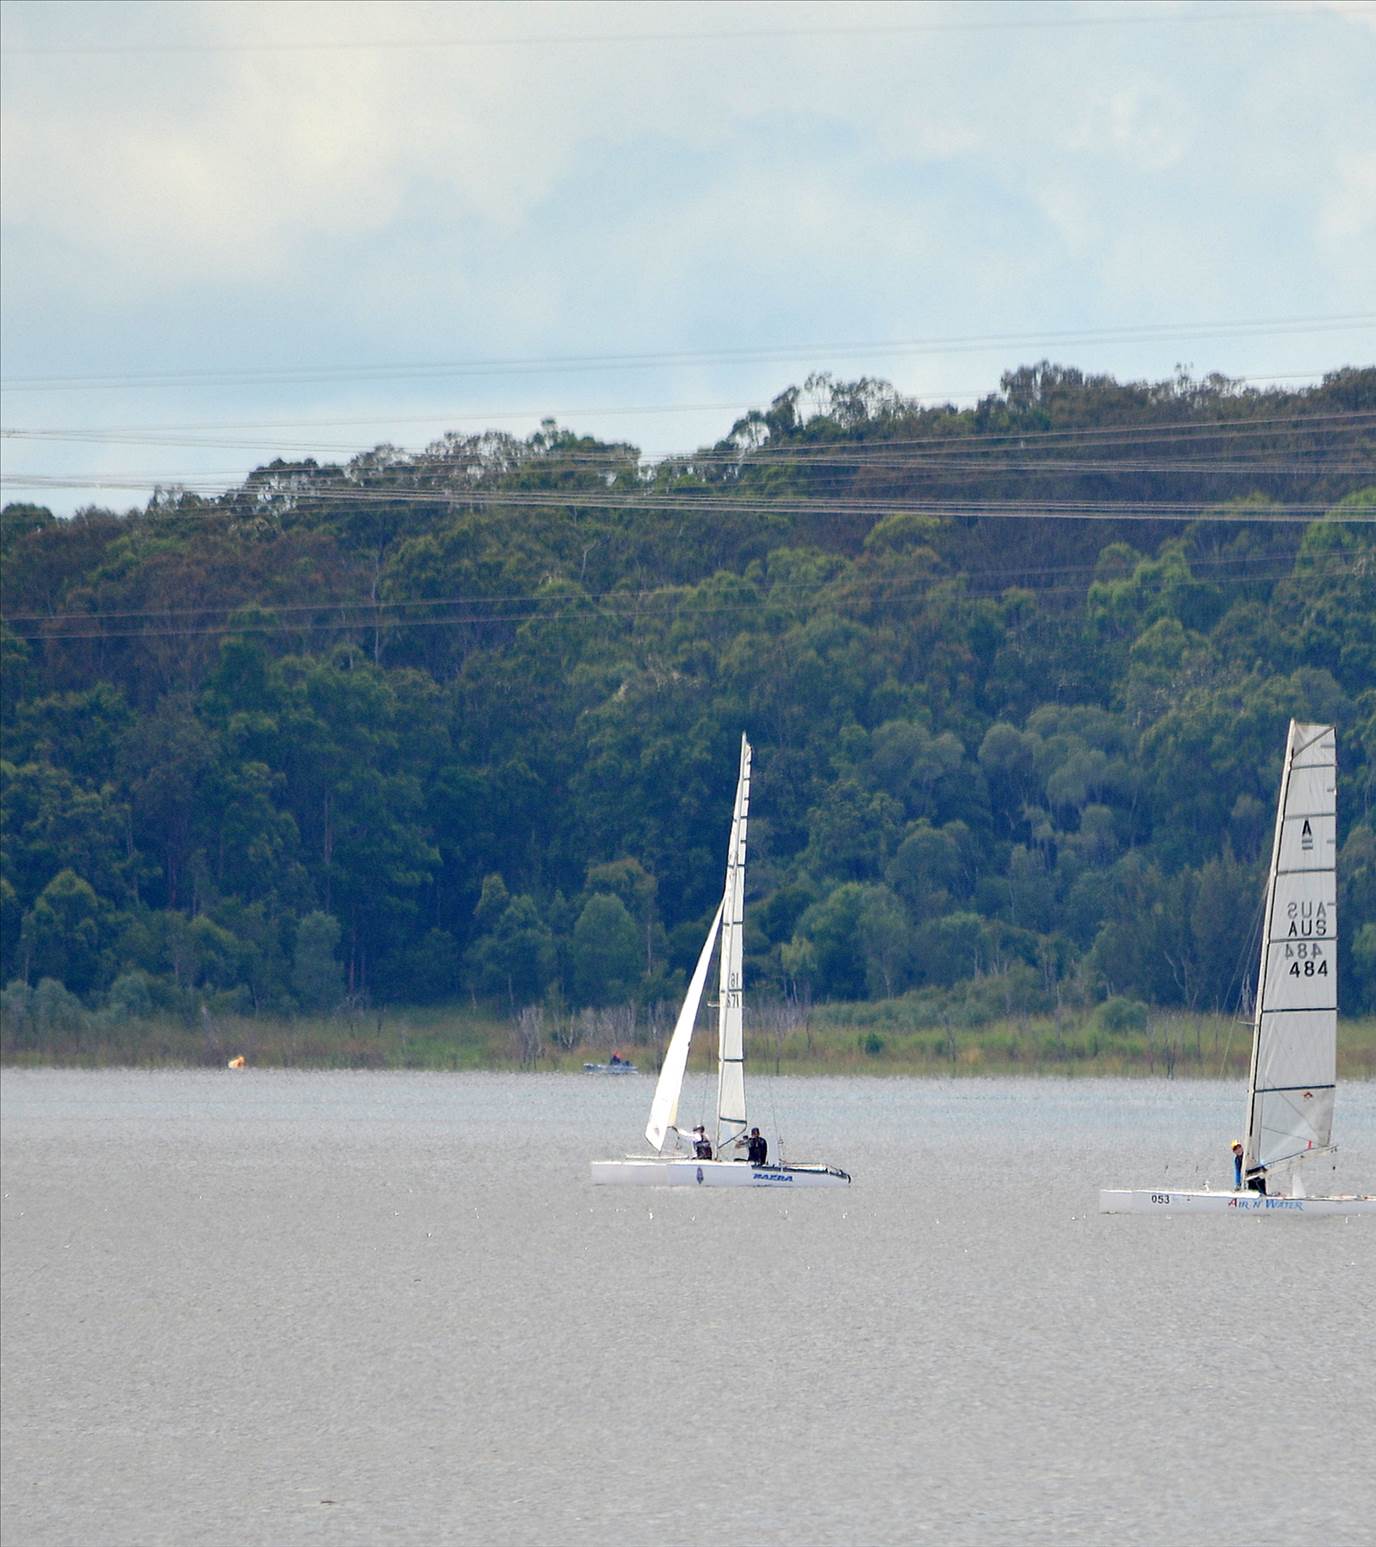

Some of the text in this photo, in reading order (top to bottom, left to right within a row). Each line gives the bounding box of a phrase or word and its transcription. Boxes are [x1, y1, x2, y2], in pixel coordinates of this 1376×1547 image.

[1288, 920, 1327, 937] AUS
[1289, 960, 1328, 978] 484
[1151, 1194, 1170, 1204] 053
